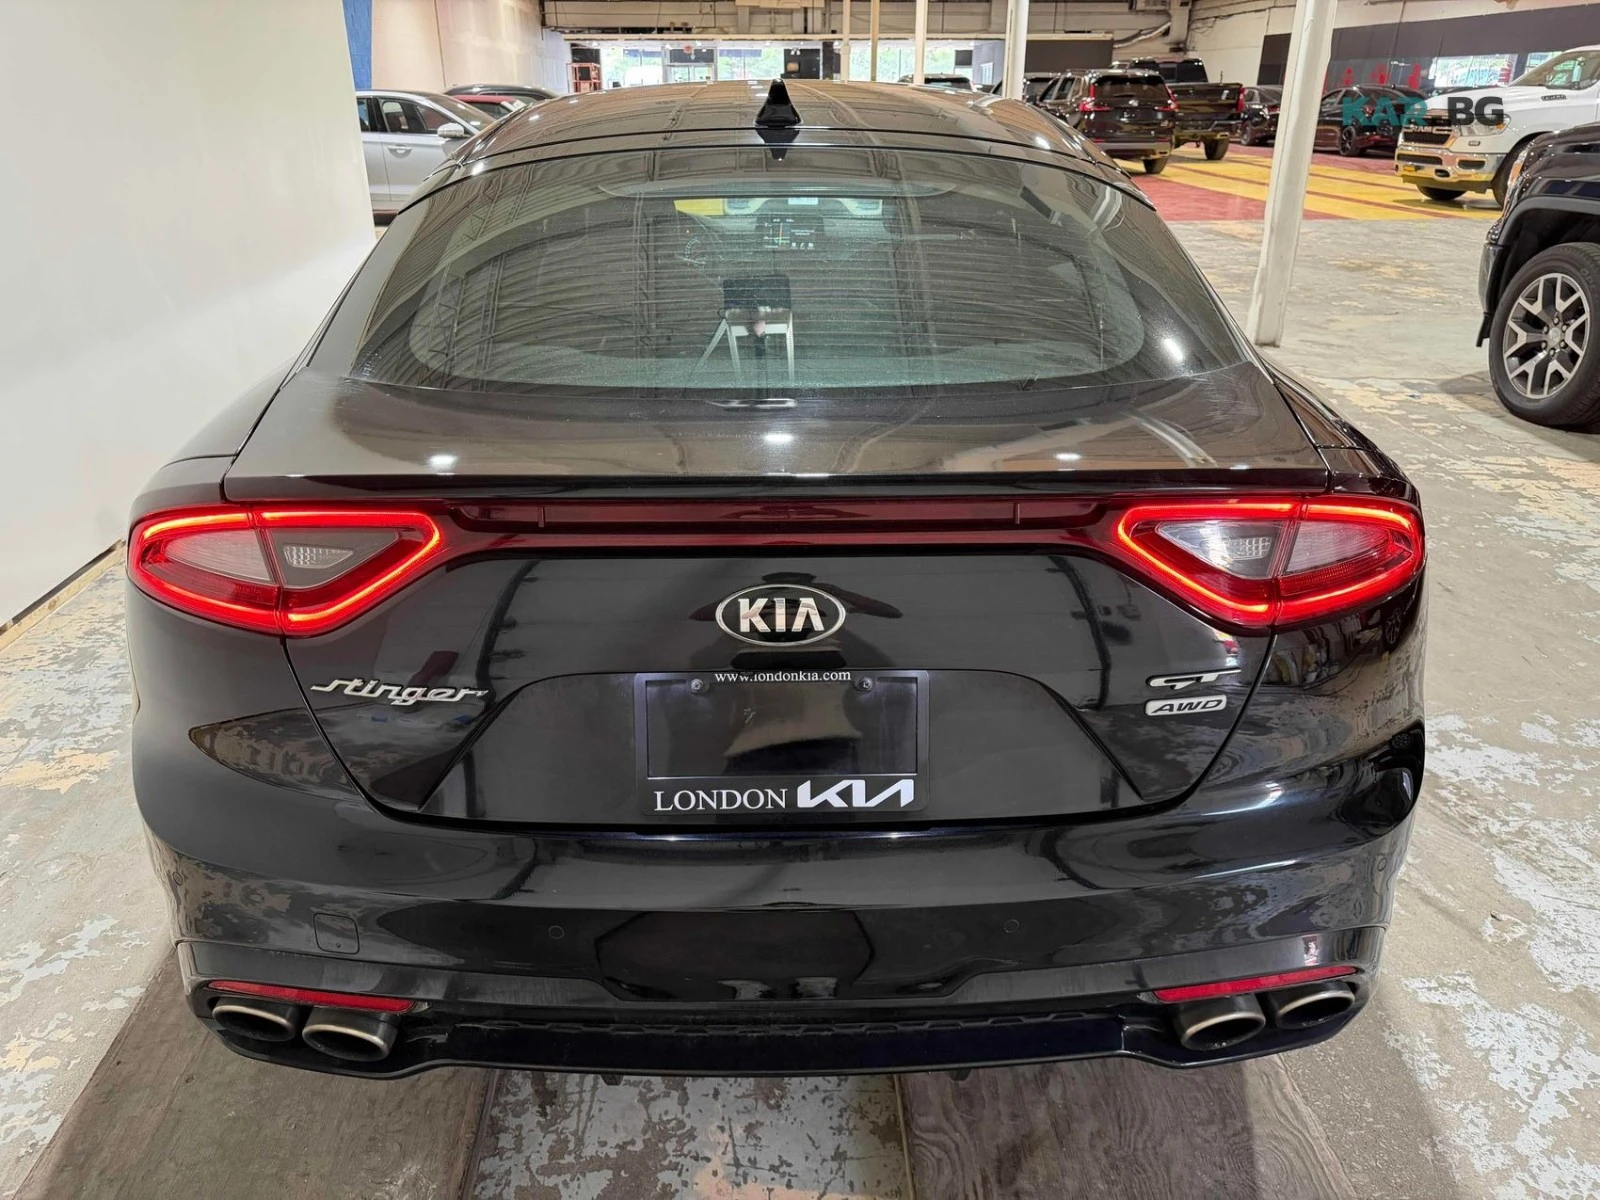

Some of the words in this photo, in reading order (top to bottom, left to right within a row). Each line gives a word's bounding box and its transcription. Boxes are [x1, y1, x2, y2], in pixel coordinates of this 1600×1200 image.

[737, 597, 825, 632] KIA
[714, 671, 851, 682] www.londonkia.com
[1149, 669, 1242, 690] GT
[1151, 699, 1223, 714] AWD
[653, 788, 788, 811] LONDON
